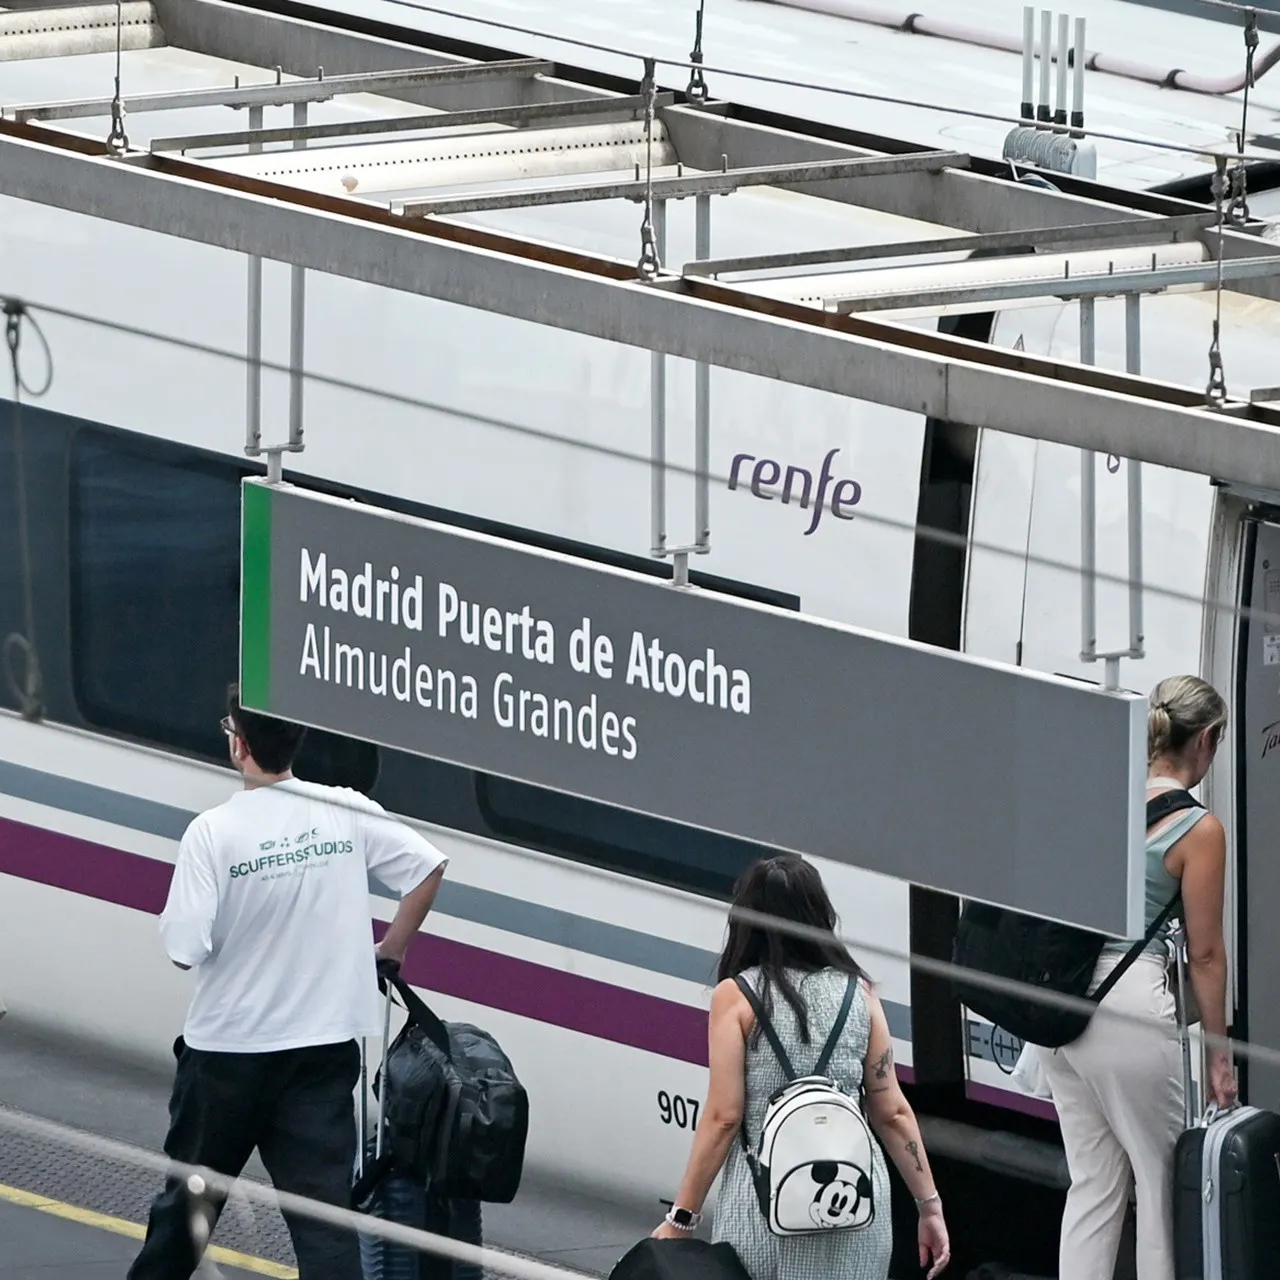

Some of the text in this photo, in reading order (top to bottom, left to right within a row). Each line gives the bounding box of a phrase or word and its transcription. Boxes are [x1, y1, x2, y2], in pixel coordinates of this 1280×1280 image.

[728, 448, 862, 535] renfe
[299, 547, 751, 715] Madrid Puerta de Atocha
[299, 623, 638, 761] Almudena Grandes
[657, 1090, 700, 1132] 907
